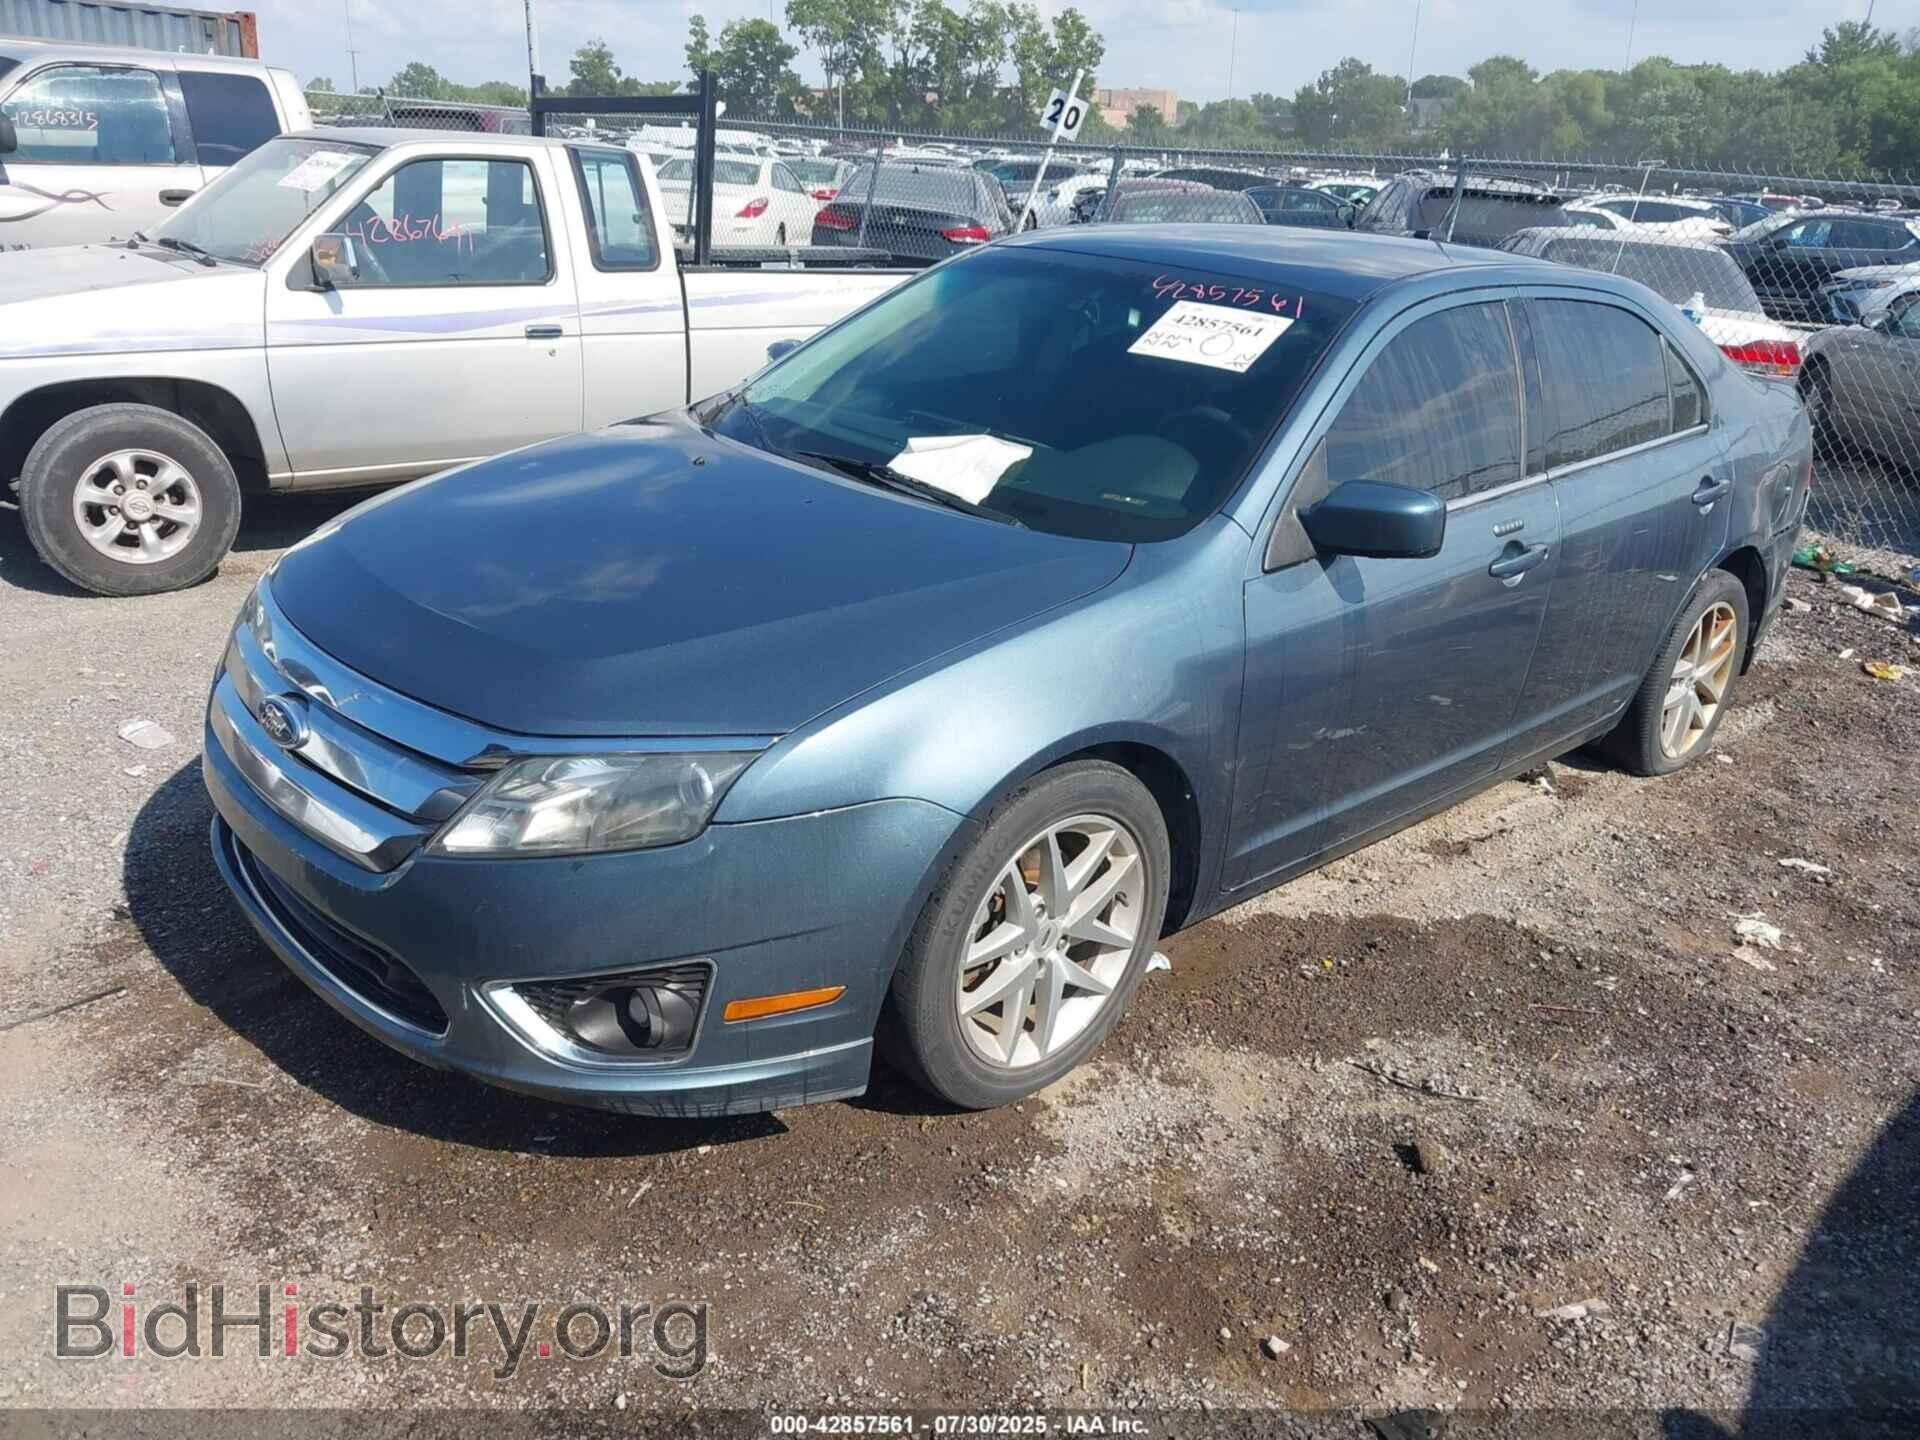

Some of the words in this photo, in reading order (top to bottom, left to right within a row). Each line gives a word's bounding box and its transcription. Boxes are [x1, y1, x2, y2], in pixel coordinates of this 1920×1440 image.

[1046, 98, 1080, 130] 20
[1172, 314, 1264, 337] 42857561
[262, 703, 287, 737] Ford
